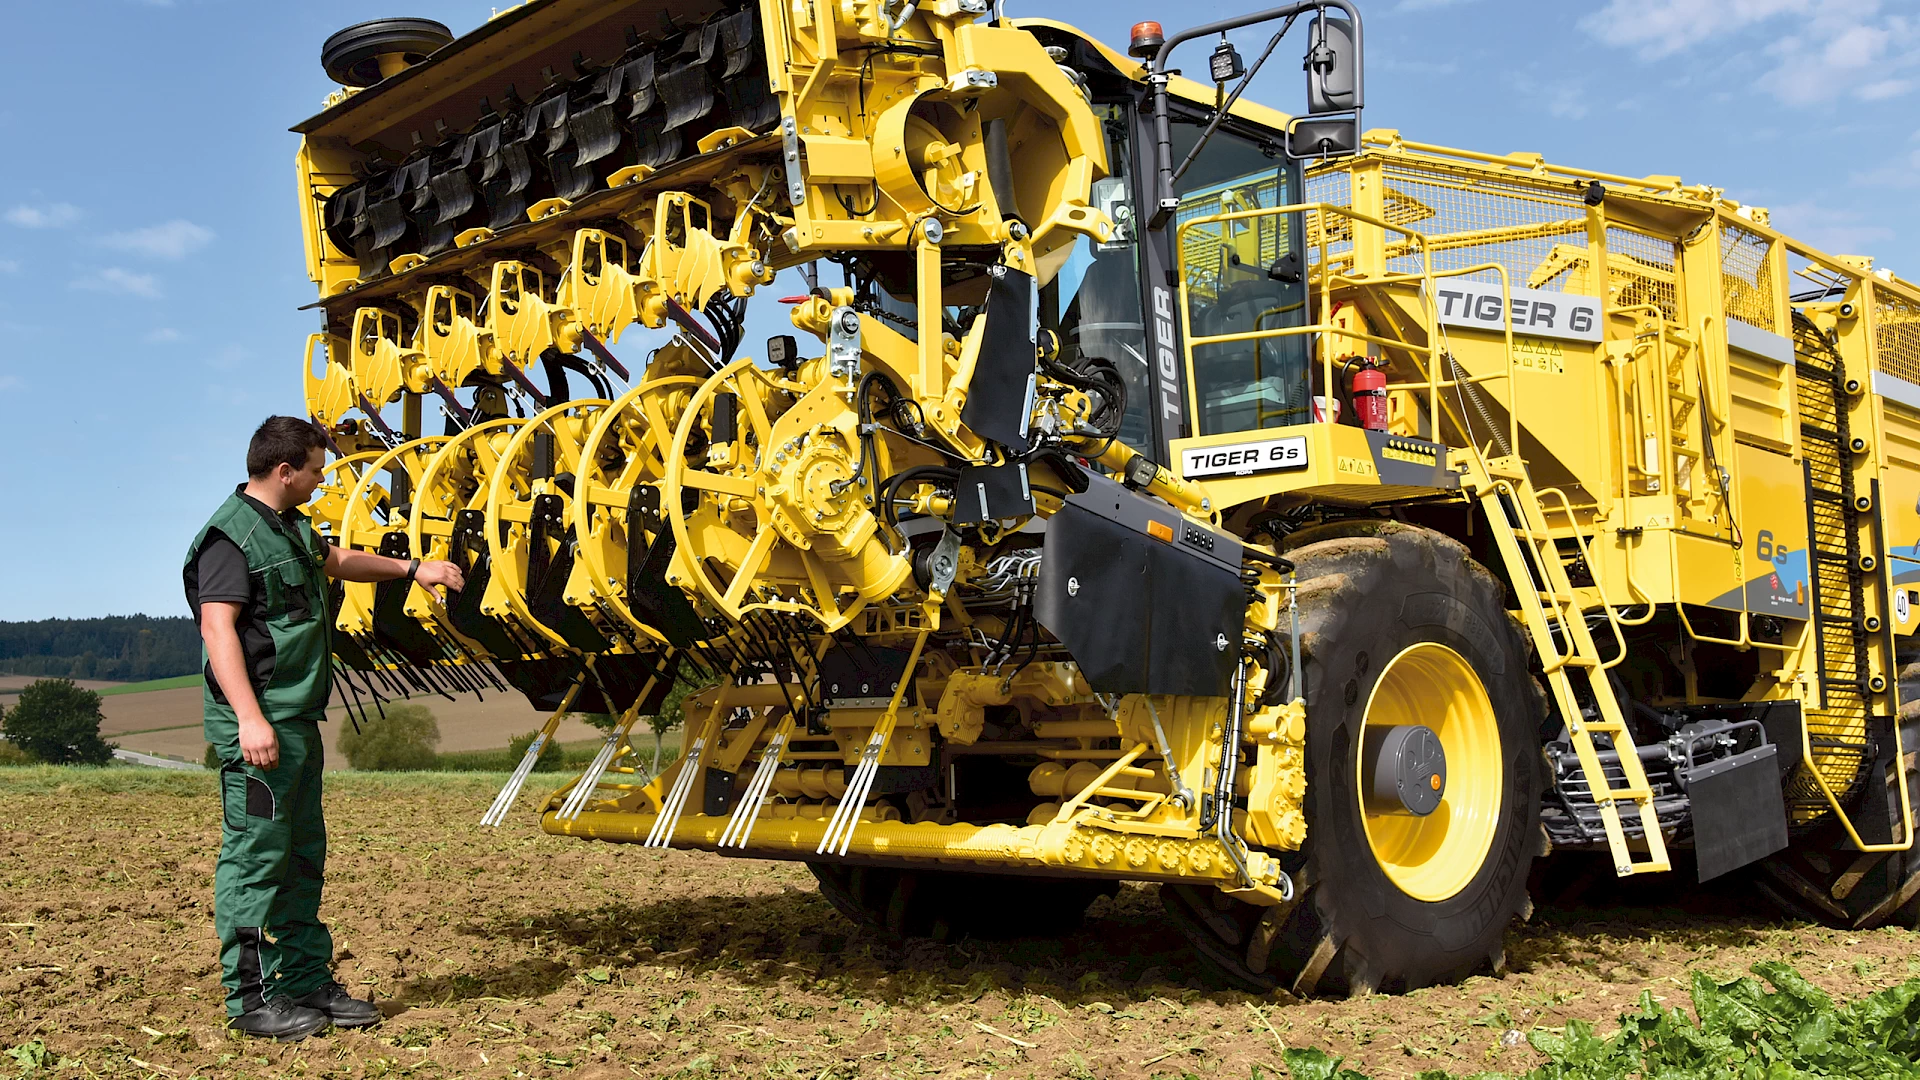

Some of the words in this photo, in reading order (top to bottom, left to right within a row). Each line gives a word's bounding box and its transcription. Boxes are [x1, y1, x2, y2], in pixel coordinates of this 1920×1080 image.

[1438, 289, 1557, 329] TIGER
[1568, 306, 1595, 333] 6
[1154, 286, 1179, 420] TIGER
[1190, 449, 1260, 470] TIGER
[1269, 446, 1299, 461] 6s
[1756, 529, 1788, 565] 6s
[1897, 595, 1907, 616] 40
[1448, 812, 1526, 946] MICHELI
